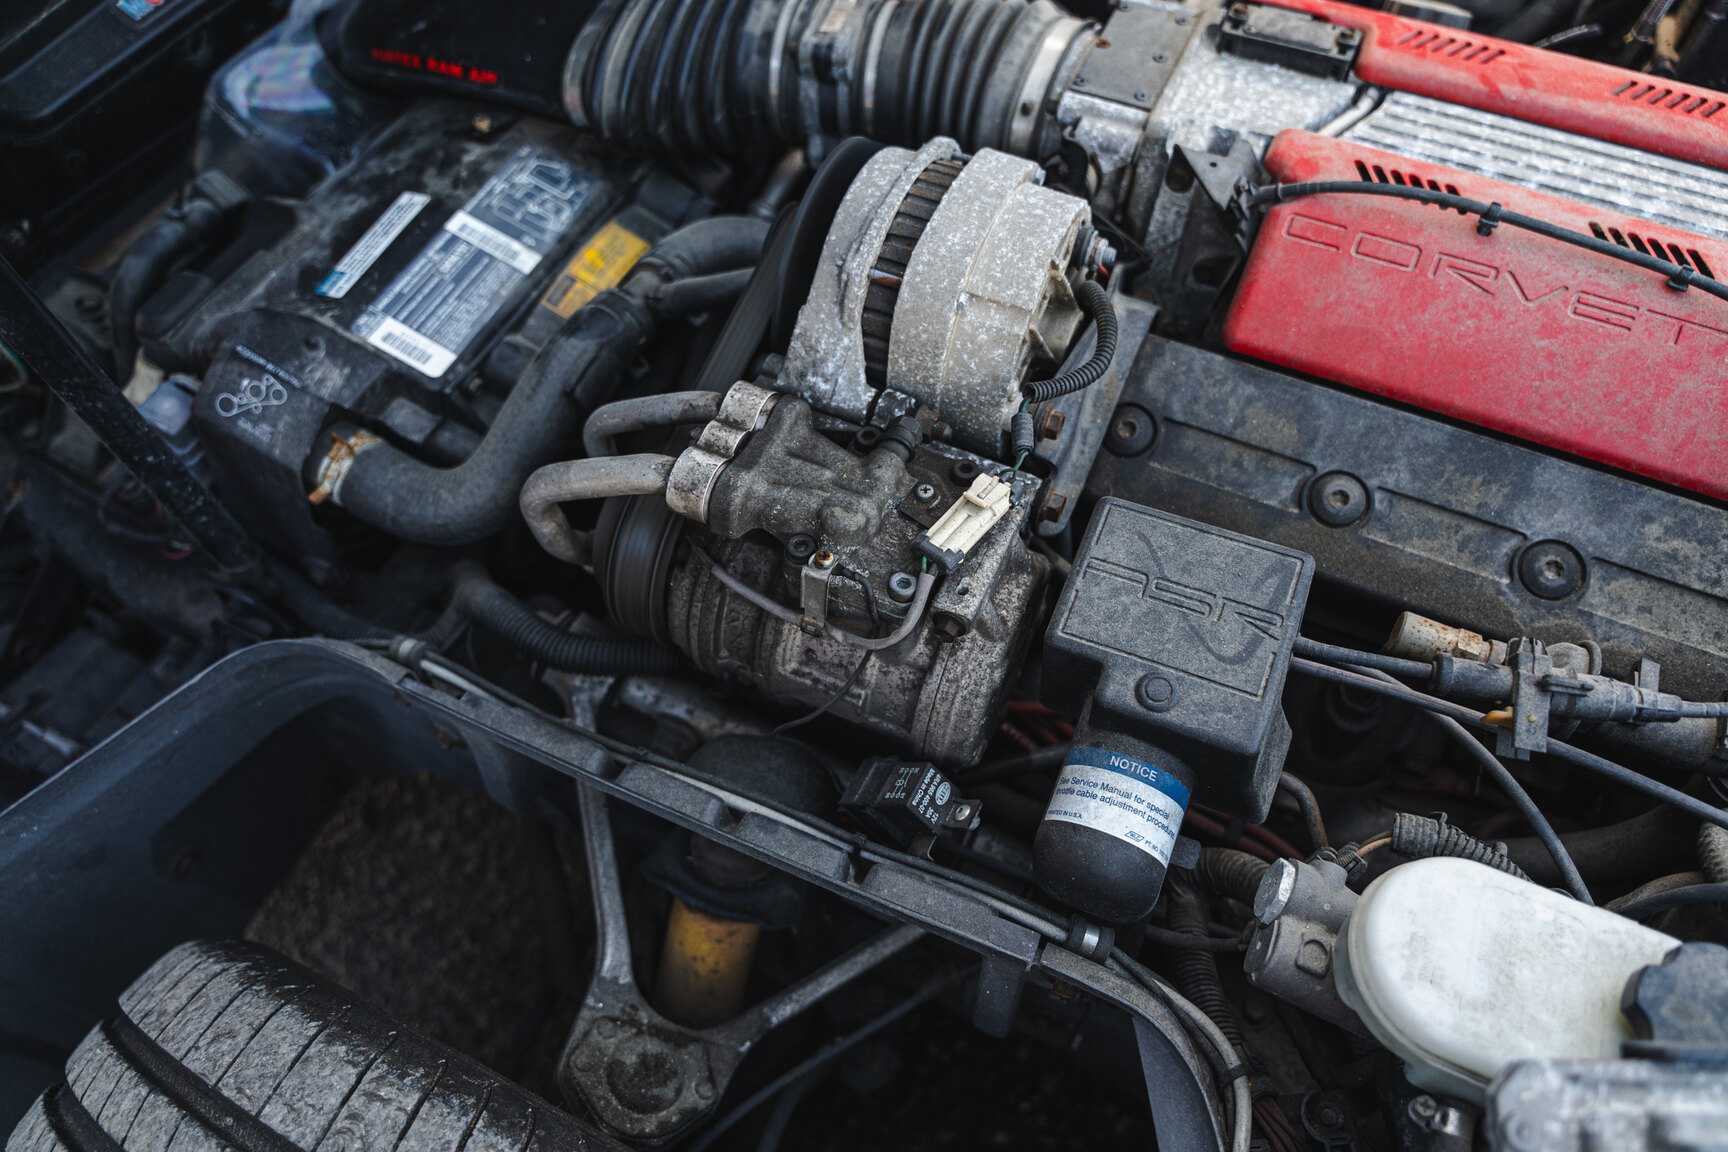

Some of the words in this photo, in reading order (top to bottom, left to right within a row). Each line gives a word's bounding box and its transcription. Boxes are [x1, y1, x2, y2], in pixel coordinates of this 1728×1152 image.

[426, 57, 463, 78] RAM
[468, 68, 498, 85] AIR
[1282, 213, 1728, 346] CORVET
[924, 768, 935, 784] Made
[1109, 755, 1158, 782] NOTICE
[912, 789, 924, 806] China
[1070, 776, 1099, 788] Service
[1100, 782, 1133, 800] Manual
[1133, 794, 1146, 805] for
[1146, 801, 1171, 820] special
[1076, 788, 1098, 800] cable
[1099, 795, 1146, 818] adjustment
